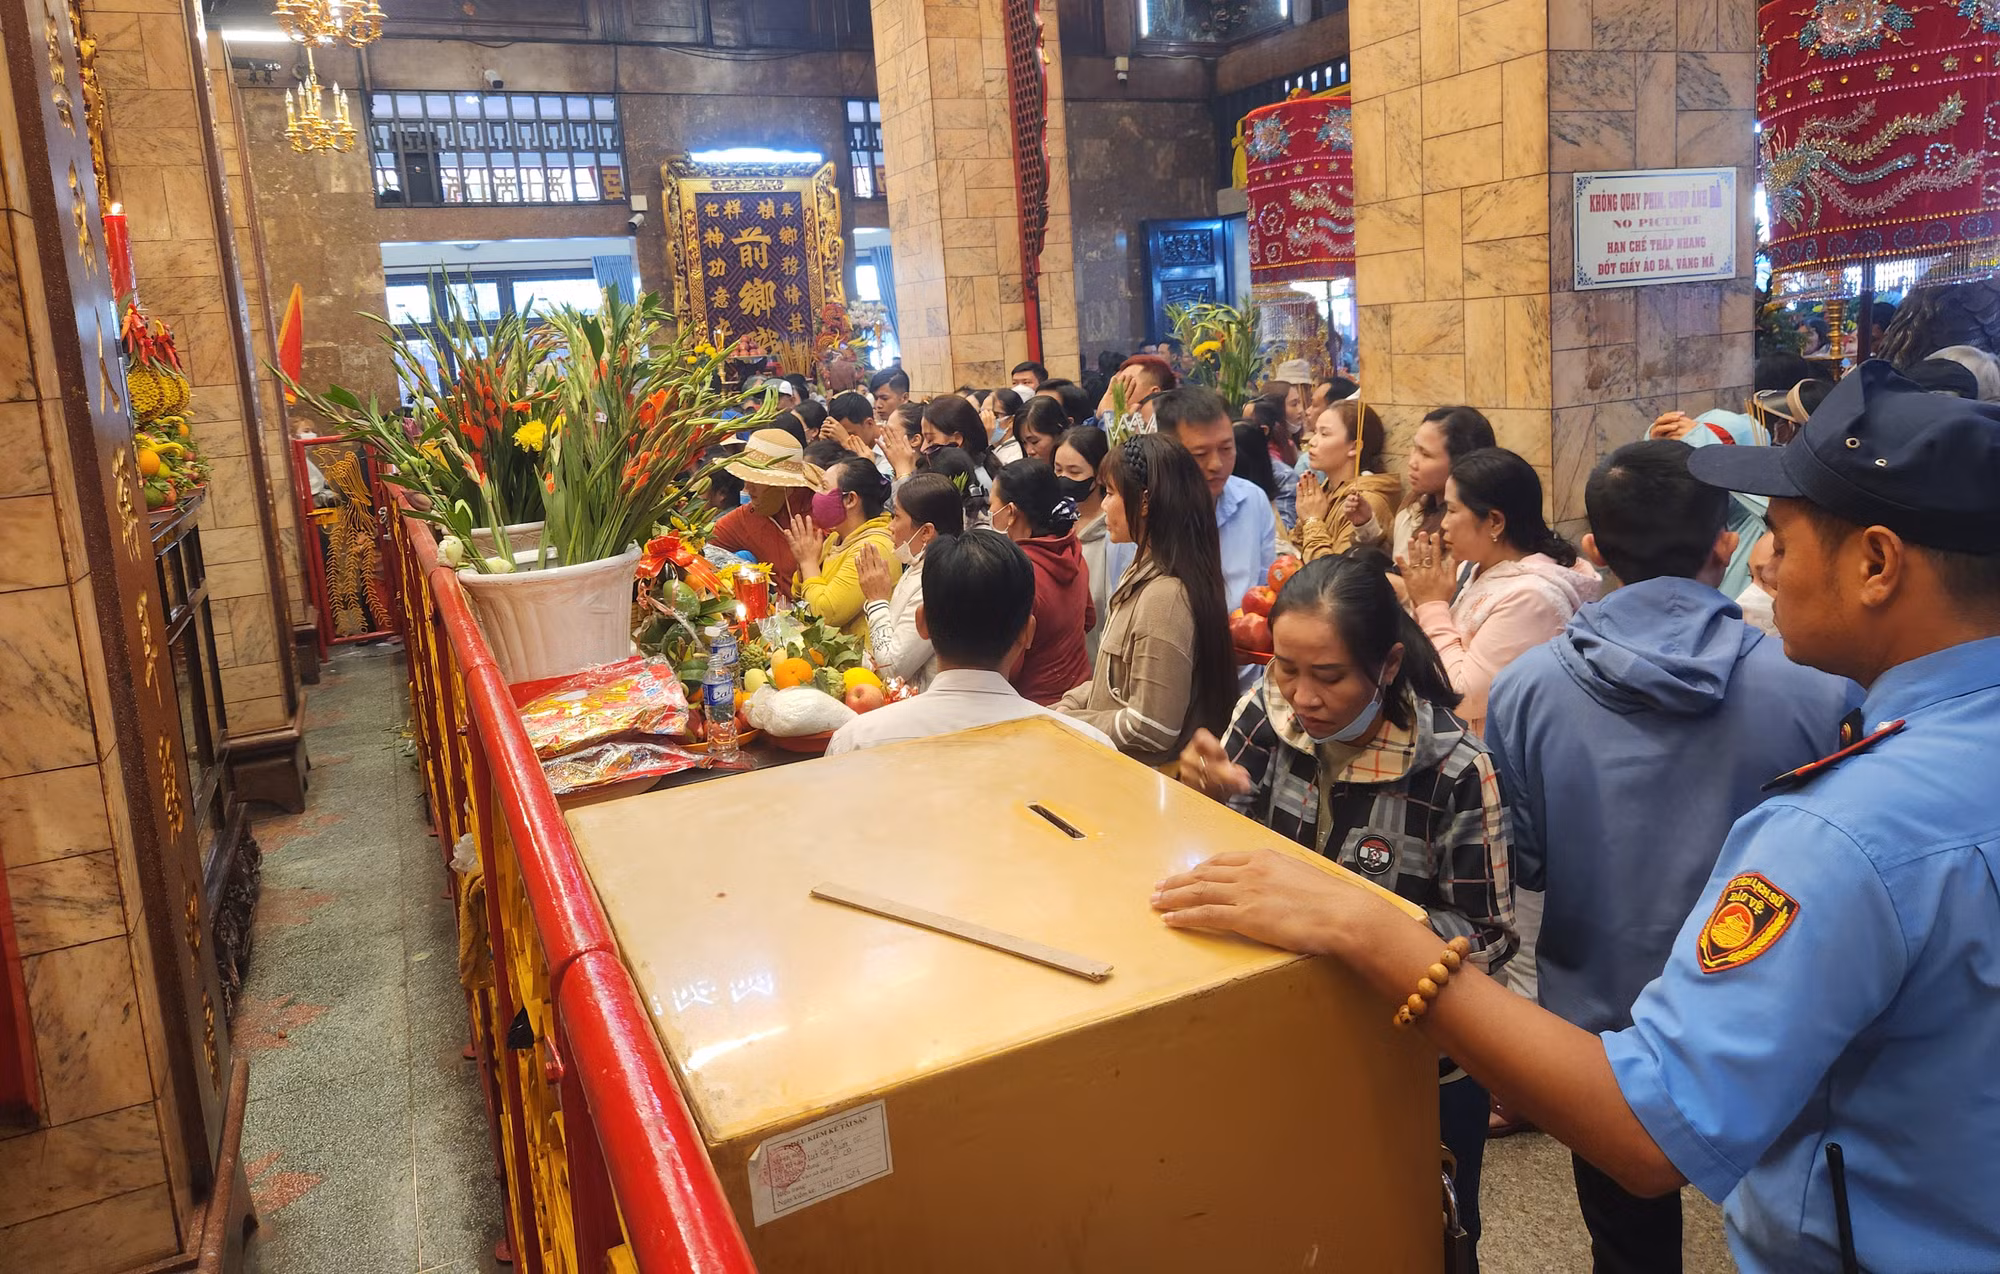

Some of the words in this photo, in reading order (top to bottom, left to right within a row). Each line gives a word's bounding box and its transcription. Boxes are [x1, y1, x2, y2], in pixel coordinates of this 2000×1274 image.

[1589, 189, 1618, 213] KHÔNG
[1620, 192, 1641, 213] QUAY
[1612, 219, 1632, 229] NO
[1638, 215, 1702, 228] PICTURE
[1607, 240, 1628, 257] HẠN
[1629, 234, 1648, 253] CHẾ
[1677, 236, 1707, 250] NHANG
[1597, 258, 1617, 276] ĐỐT
[1619, 257, 1640, 274] GIẤY
[1643, 256, 1656, 272] ÁO
[1676, 255, 1699, 271] VÀNG
[1728, 889, 1749, 902] BẢO
[1749, 895, 1765, 915] VỆ
